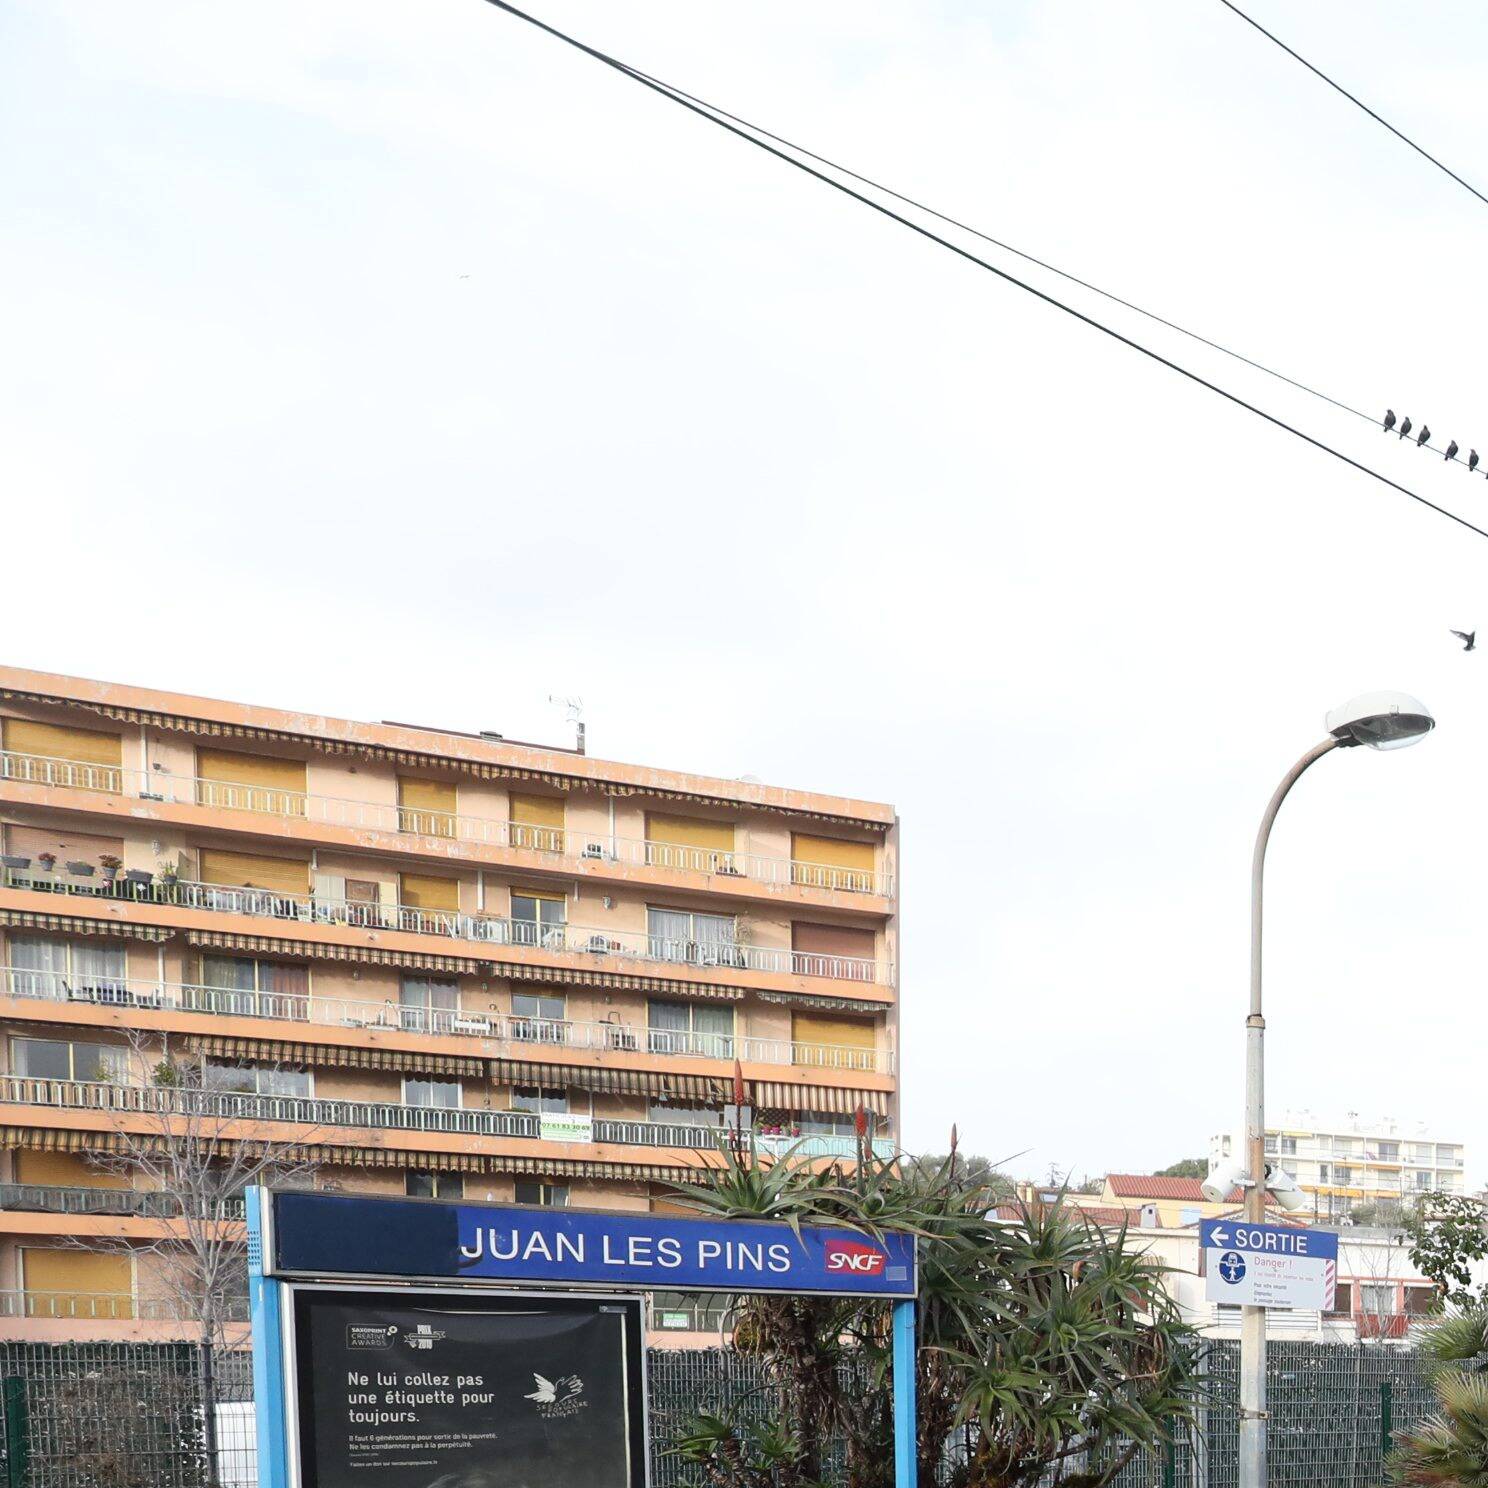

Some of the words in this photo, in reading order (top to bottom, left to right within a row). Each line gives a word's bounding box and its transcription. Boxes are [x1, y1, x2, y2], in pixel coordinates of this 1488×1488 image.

[461, 1227, 585, 1263] JUAN
[603, 1234, 682, 1268] LES
[698, 1239, 792, 1273] PINS
[1235, 1229, 1308, 1254] SORTIE
[828, 1252, 885, 1271] SNCF
[1254, 1256, 1286, 1269] Danger
[348, 1372, 369, 1386] Ne
[377, 1372, 398, 1386] lui
[404, 1372, 450, 1386] collez
[457, 1374, 483, 1389] pas
[348, 1393, 377, 1405] une
[385, 1390, 455, 1407] étiquette
[462, 1393, 495, 1407] pour
[349, 1409, 420, 1426] toujours.
